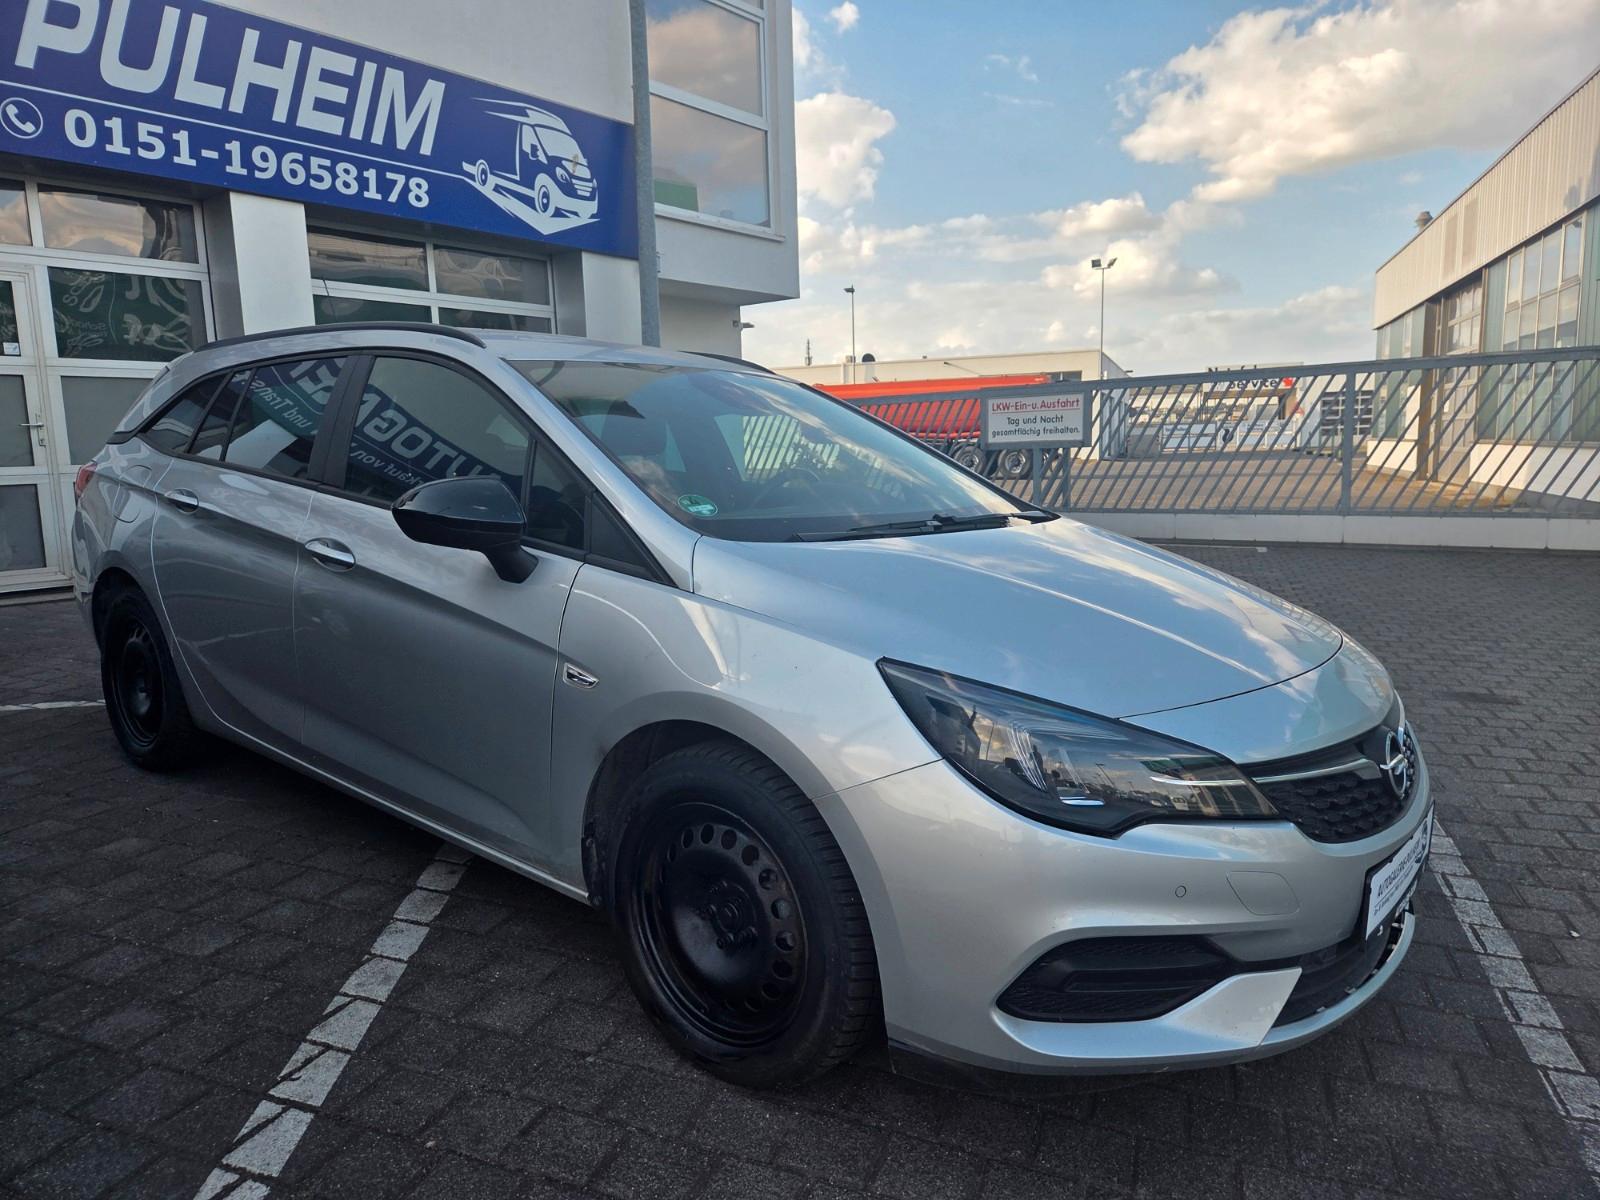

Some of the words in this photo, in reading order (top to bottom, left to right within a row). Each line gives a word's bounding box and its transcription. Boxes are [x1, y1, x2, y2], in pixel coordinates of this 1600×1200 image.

[14, 0, 445, 156] PULHEIM
[63, 108, 430, 209] 0151-19658178
[1007, 417, 1019, 426] Tag
[1023, 416, 1037, 425] und
[1040, 415, 1064, 424] Nacht
